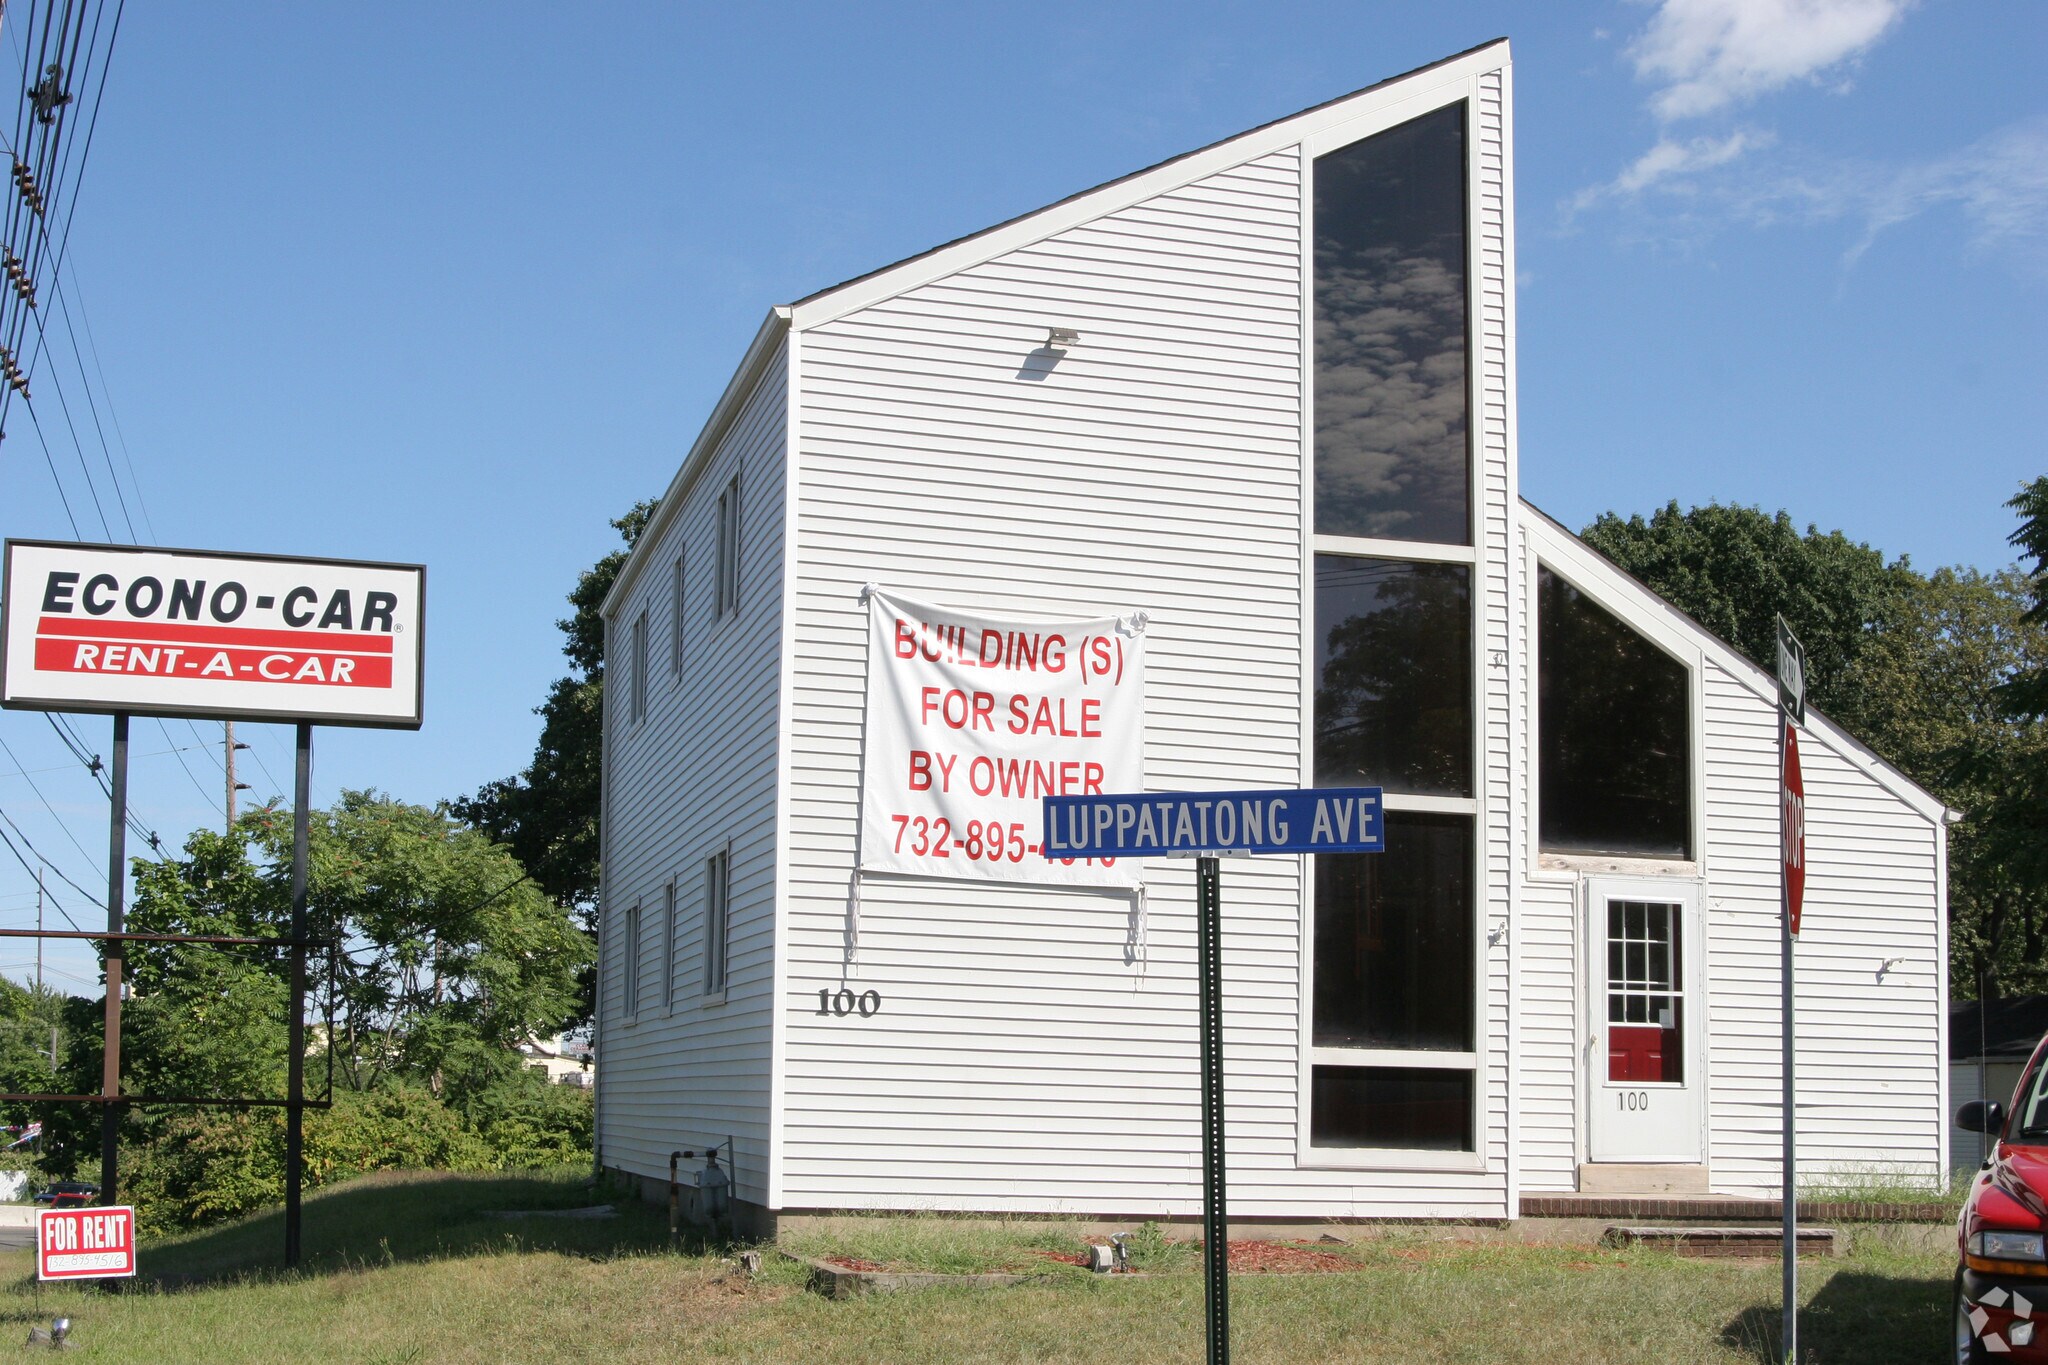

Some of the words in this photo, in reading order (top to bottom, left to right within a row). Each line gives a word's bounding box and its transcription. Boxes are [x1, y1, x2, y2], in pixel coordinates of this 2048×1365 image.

[73, 644, 356, 683] RENT-A-CAR
[895, 618, 1067, 674] BUILDING
[1079, 634, 1124, 686] (S)
[921, 686, 995, 732] FOR
[1007, 693, 1102, 738] SALE
[908, 750, 957, 793] BY
[969, 755, 1104, 799] OWNER
[891, 814, 1116, 868] 732-895-
[1050, 798, 1288, 849] LUPPATATONG
[1311, 797, 1377, 844] AVE
[1784, 785, 1803, 869] STOP
[815, 988, 881, 1018] 100
[1618, 1091, 1649, 1111] 100
[45, 1217, 78, 1251] FOR
[82, 1214, 127, 1249] RENT
